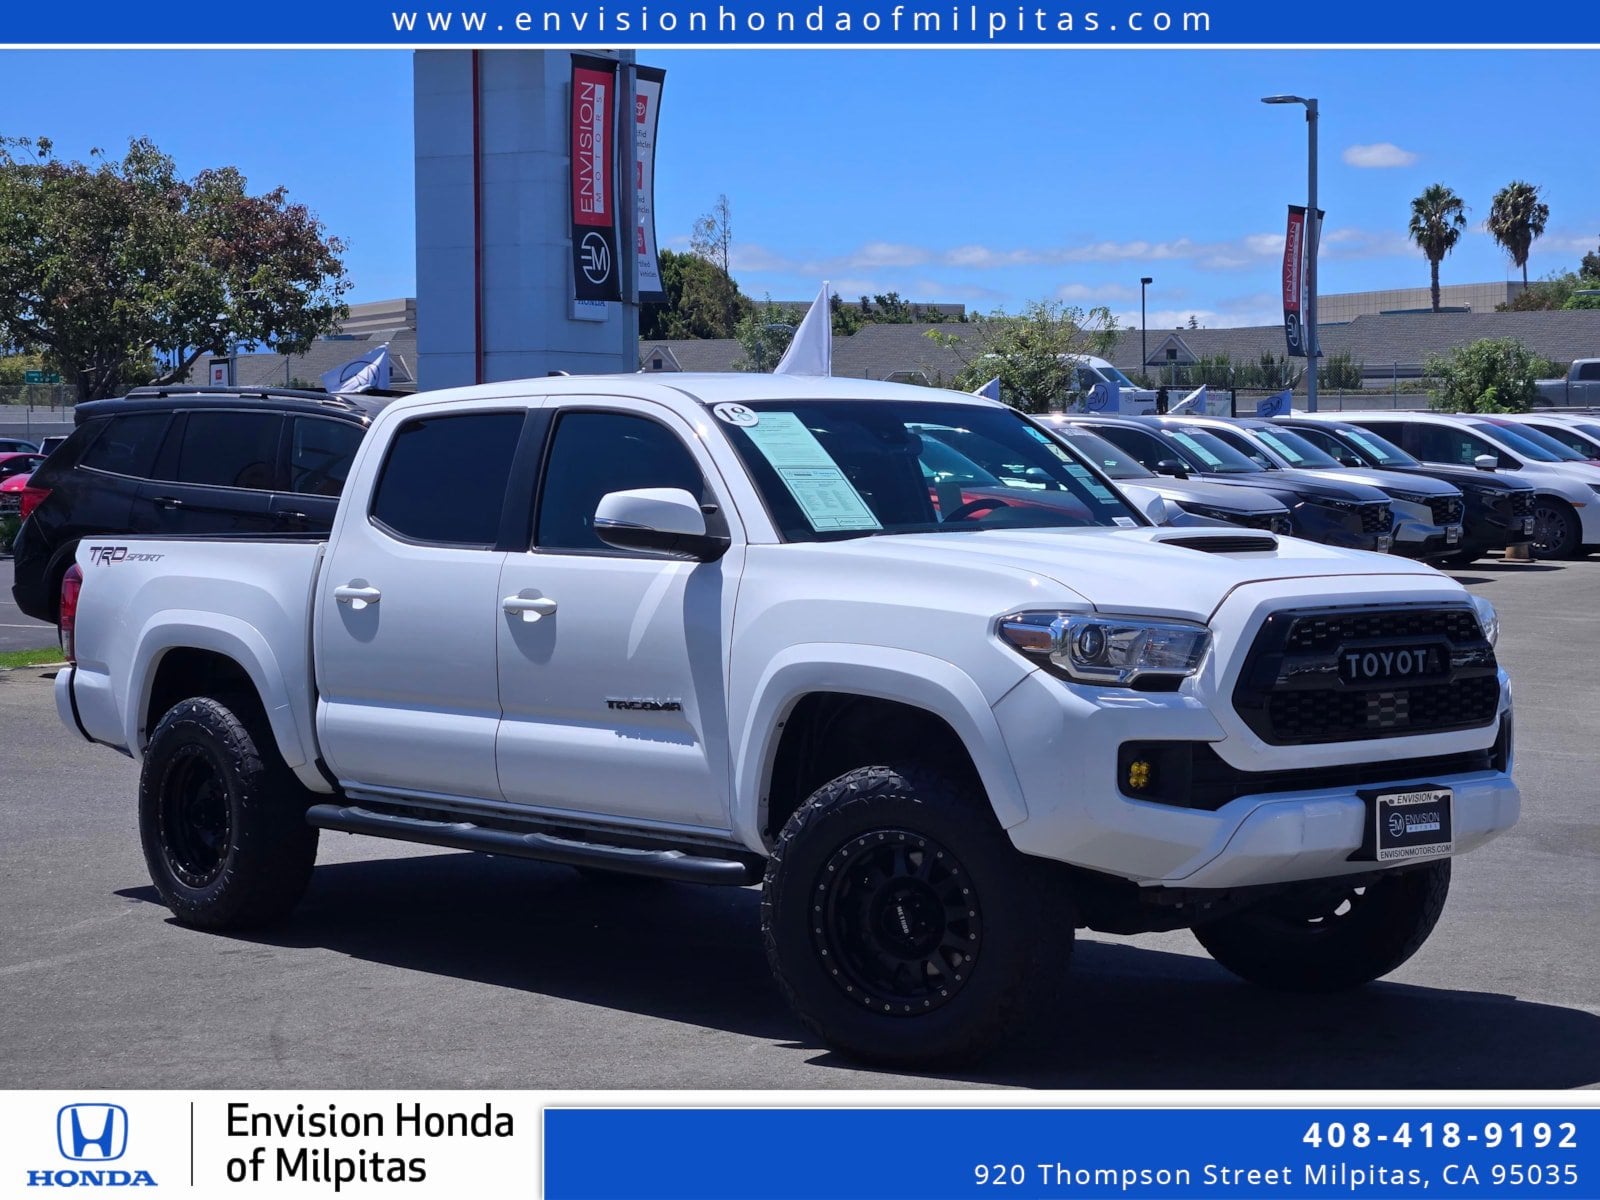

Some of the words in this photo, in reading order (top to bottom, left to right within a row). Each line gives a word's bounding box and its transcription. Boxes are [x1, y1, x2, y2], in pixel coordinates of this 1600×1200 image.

[579, 81, 594, 213] ENVISION
[89, 546, 128, 566] TRD
[125, 553, 165, 562] SPORT
[605, 697, 682, 712] TACOMA
[1396, 793, 1433, 804] ENVISION
[1405, 811, 1440, 825] ENVISION
[1380, 844, 1452, 860] ENVISIONMOTORS.COM
